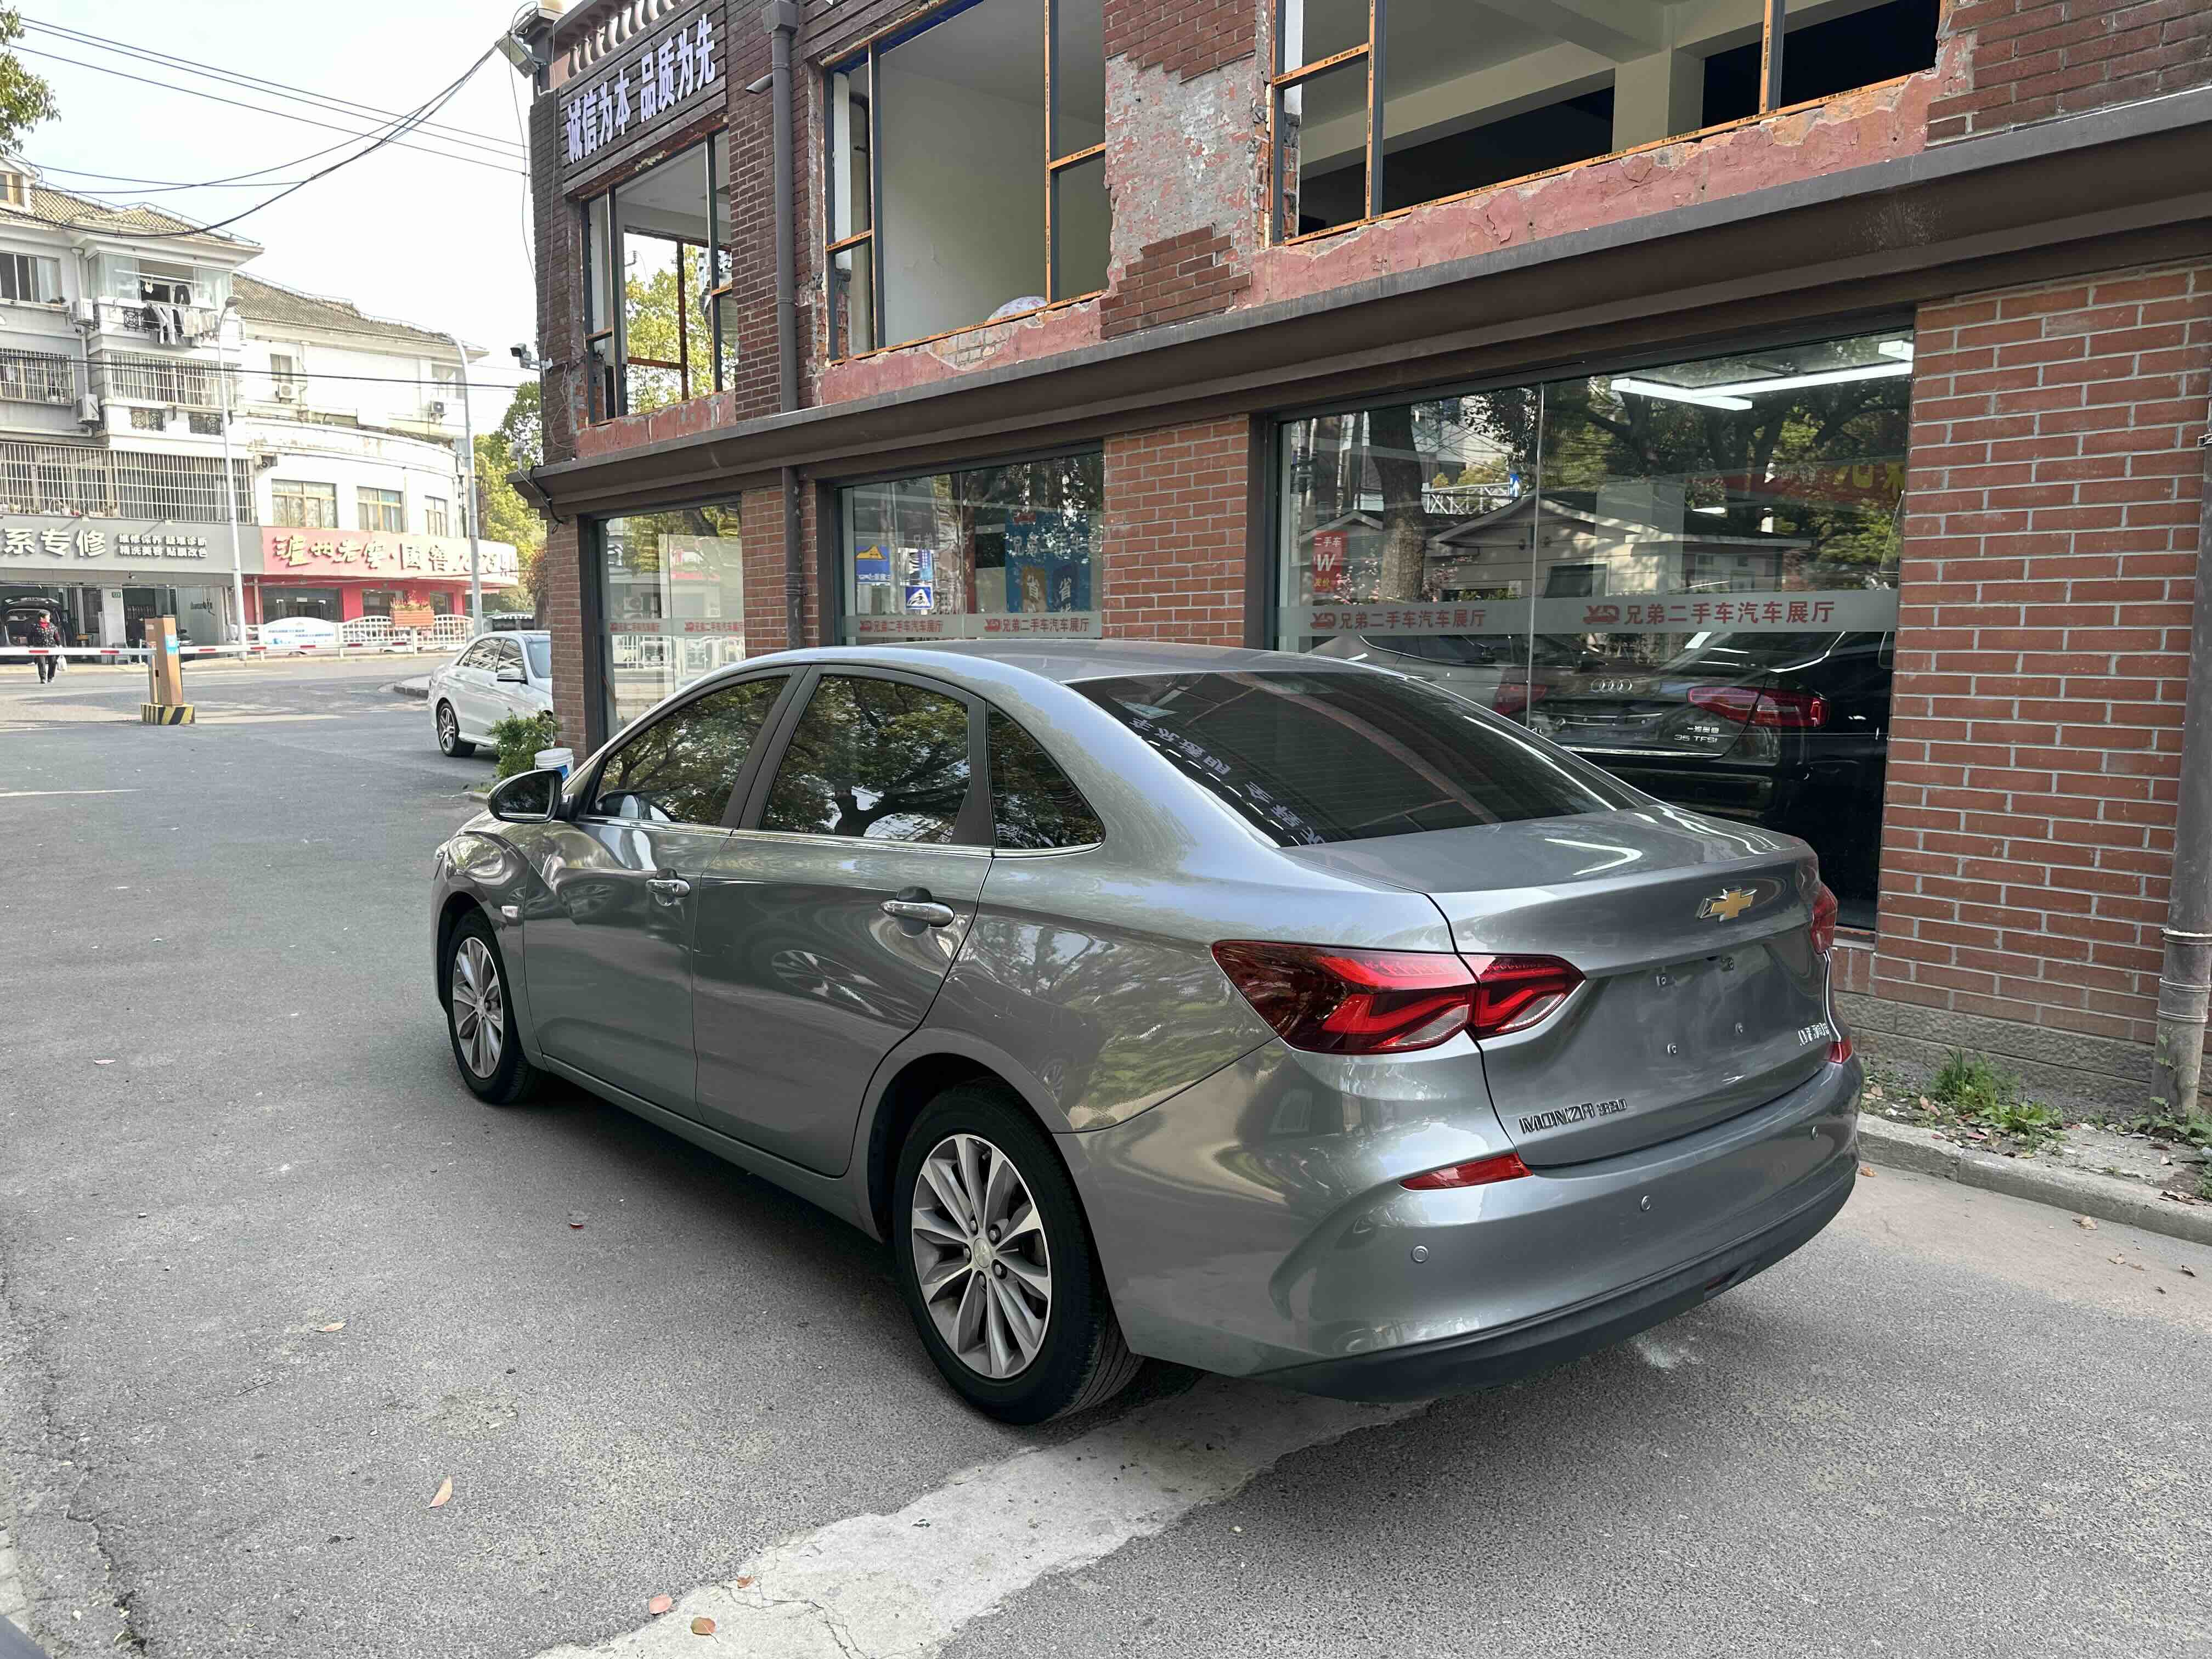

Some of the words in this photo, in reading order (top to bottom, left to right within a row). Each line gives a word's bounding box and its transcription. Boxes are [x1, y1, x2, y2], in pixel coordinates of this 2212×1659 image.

[566, 69, 631, 163] 诚信为本
[640, 14, 715, 122] 品质为先
[4, 527, 106, 557] 系专修
[119, 533, 162, 544] 维修保养
[165, 535, 207, 546] 疑难诊断
[1314, 536, 1342, 548] 二手车
[119, 545, 162, 556] 精洗美容
[166, 547, 207, 558] 贴膜改色
[1339, 609, 1487, 630] 兄弟二手车汽车展厅
[1623, 601, 1836, 624] 兄弟二手车汽车展厅
[873, 619, 944, 632] 兄弟二手车汽车展厅
[1002, 618, 1089, 633] 兄弟二手车汽车展厅
[1519, 1103, 1595, 1134] MONZA
